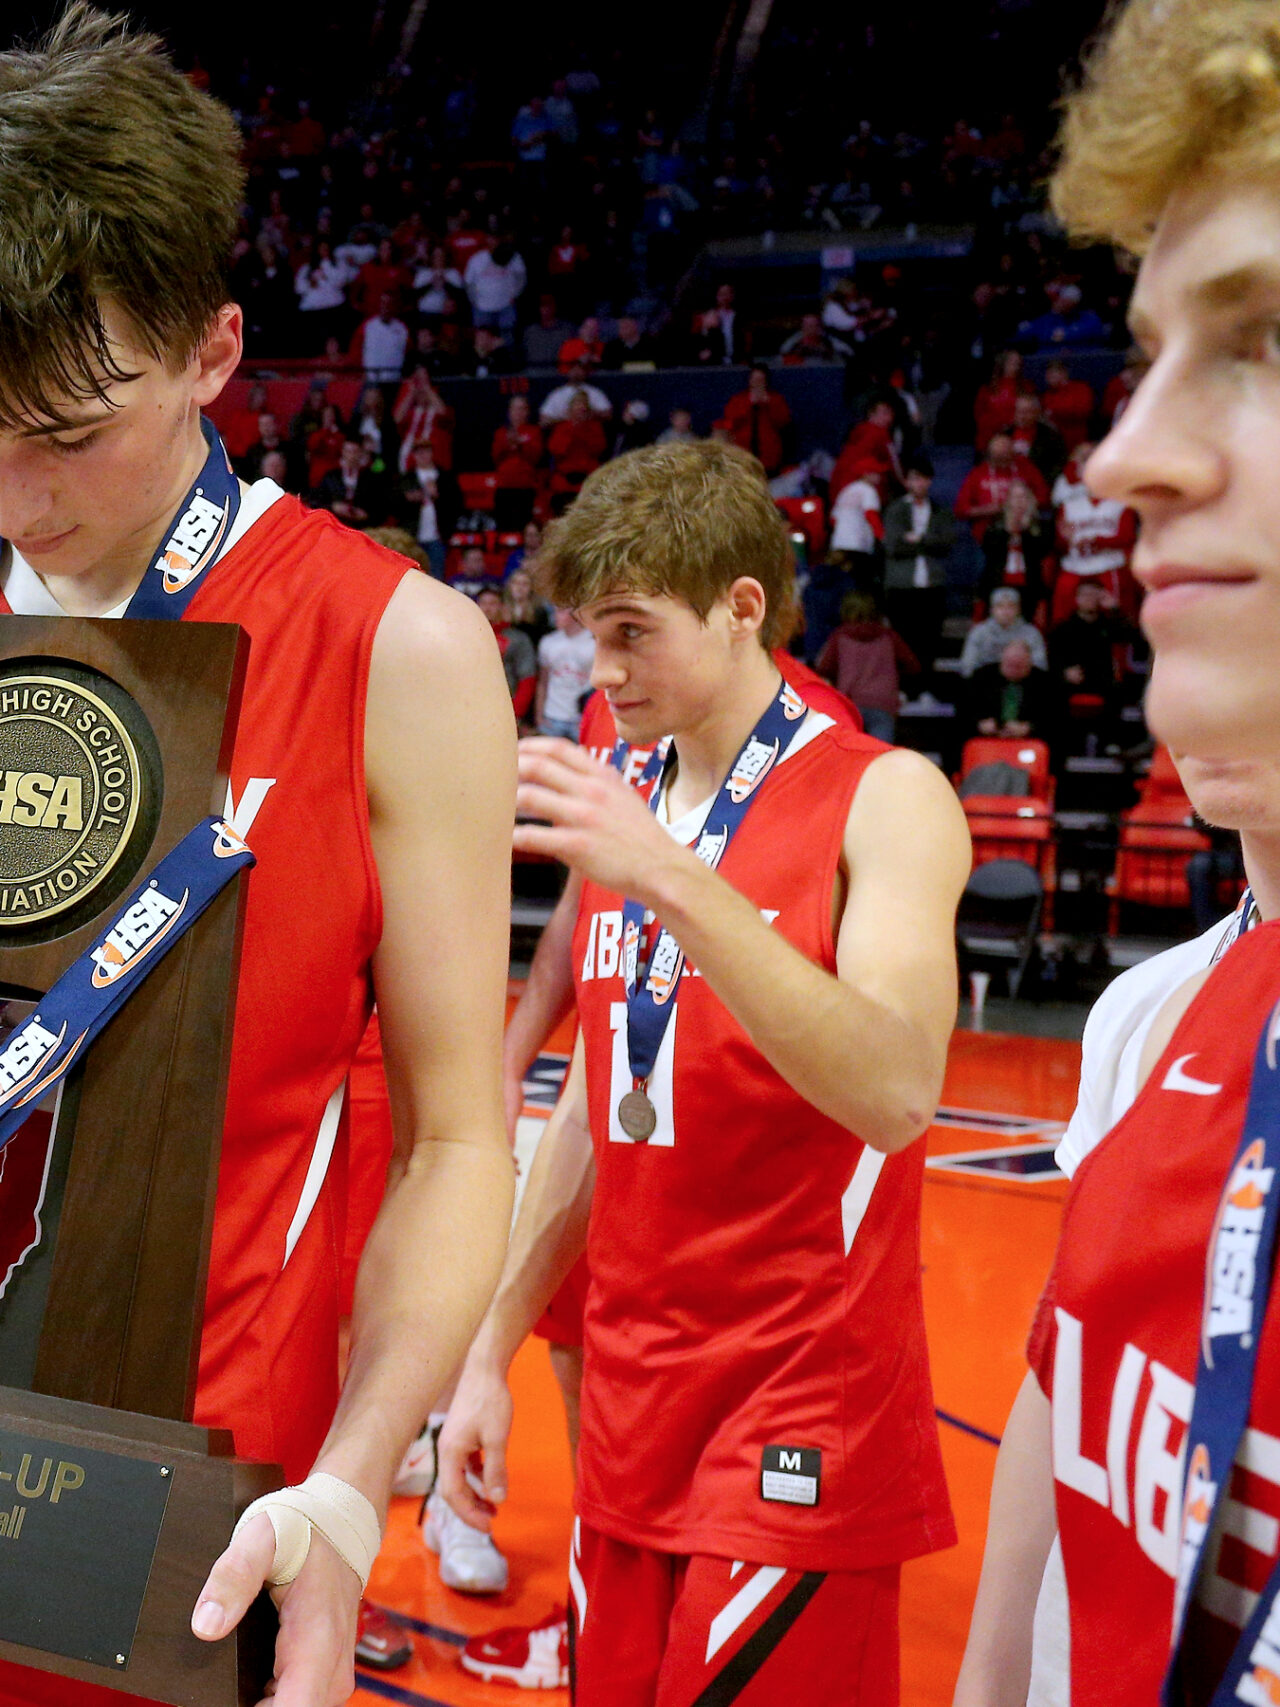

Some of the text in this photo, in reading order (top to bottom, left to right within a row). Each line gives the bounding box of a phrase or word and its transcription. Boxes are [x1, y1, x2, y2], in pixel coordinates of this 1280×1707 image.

[155, 494, 225, 584] IHSA
[2, 689, 75, 718] HIGH
[76, 710, 126, 830] SCHOOL
[90, 887, 180, 979] IHSA
[1207, 1167, 1275, 1338] IHSA
[779, 1450, 801, 1471] M
